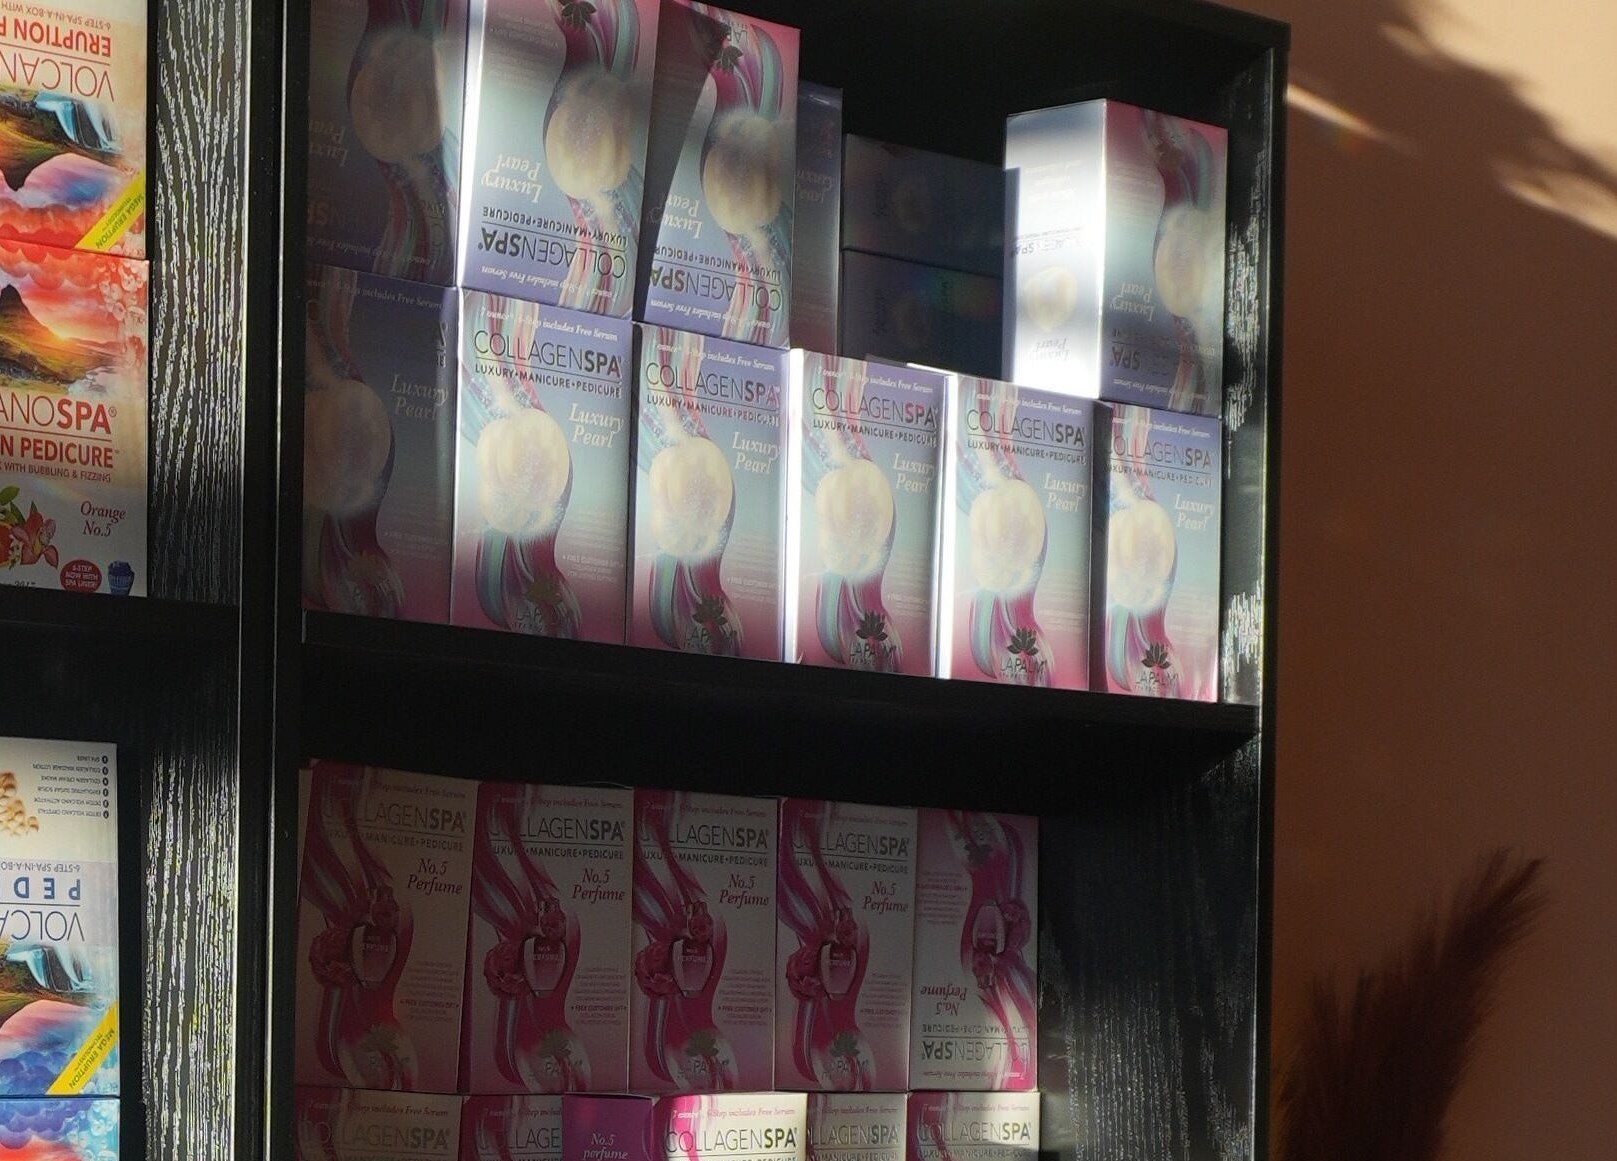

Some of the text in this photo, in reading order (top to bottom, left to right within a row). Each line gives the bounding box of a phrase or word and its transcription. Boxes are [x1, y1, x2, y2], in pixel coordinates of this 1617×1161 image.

[14, 21, 110, 58] ERUPTION
[495, 154, 542, 178] Pearl
[482, 165, 543, 203] Luxury
[569, 404, 625, 432] Luxury
[573, 428, 614, 449] Pearl
[733, 432, 781, 460] Luxury
[734, 453, 773, 475] Pearl
[896, 476, 930, 492] Pearl
[81, 500, 126, 522] Orange
[1046, 494, 1081, 512] Pearl
[1175, 495, 1214, 515] Luxury
[83, 519, 112, 536] No.5
[1177, 513, 1207, 531] Pearl
[418, 858, 447, 874] No.5
[583, 868, 610, 883] No.5
[407, 877, 463, 896] Perfume
[728, 874, 755, 888] No.5
[572, 885, 625, 904] Perfume
[719, 891, 769, 908] Perfume
[591, 1133, 615, 1146] No.5
[583, 1149, 628, 1161] perfume
